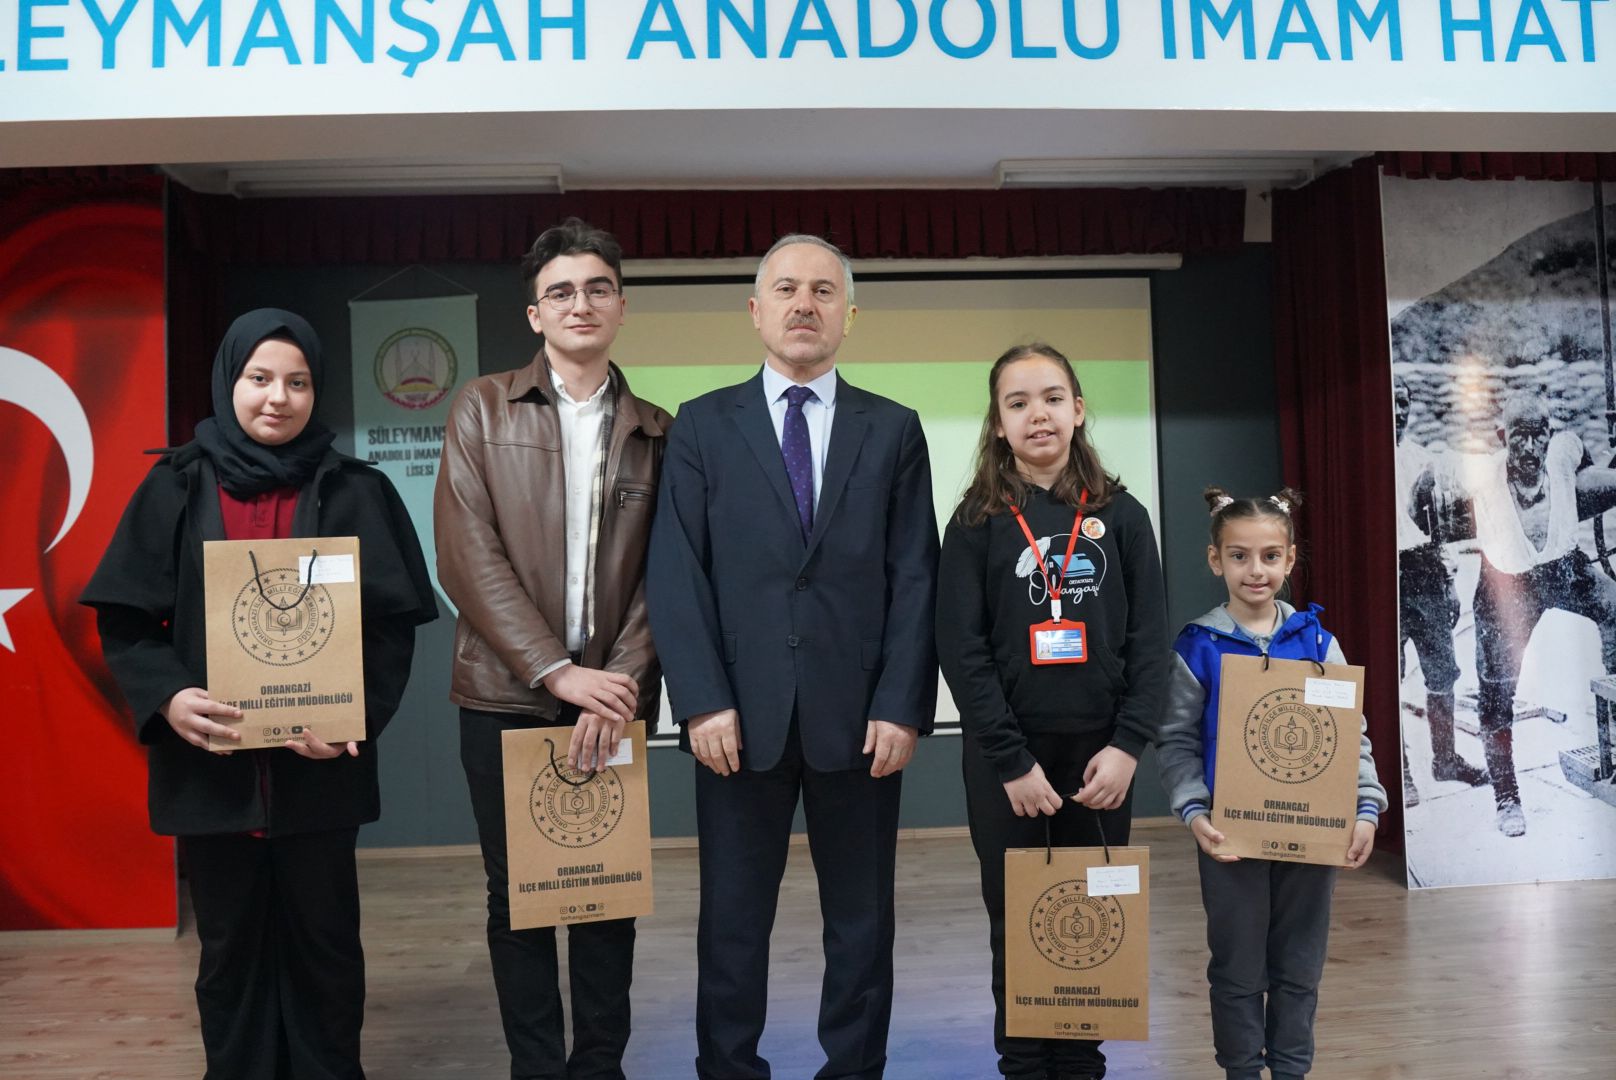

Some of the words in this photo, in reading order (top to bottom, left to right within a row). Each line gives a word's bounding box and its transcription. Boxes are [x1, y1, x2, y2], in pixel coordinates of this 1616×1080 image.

[0, 0, 587, 79] EYMANŞAH
[627, 0, 1121, 60] ANADOLU
[368, 449, 411, 462] ANADOLU
[405, 461, 434, 477] LİSESİ
[260, 682, 312, 696] ORHANGAZİ
[239, 698, 263, 711] MİLLİ
[264, 695, 296, 709] EĞİTİM
[297, 692, 353, 707] MÜDÜRLÜĞÜ
[1264, 799, 1309, 813] ORHANGAZİ
[1224, 807, 1242, 821] İLÇE
[1243, 809, 1265, 821] MİLLİ
[1266, 812, 1295, 825] EĞİTİM
[1296, 815, 1346, 829] MÜDÜRLÜĞÜ
[557, 862, 604, 877] ORHANGAZİ
[519, 882, 537, 894] İLÇE
[538, 878, 560, 891] MİLLİ
[561, 875, 590, 889] EĞİTİM
[591, 870, 642, 886] MÜDÜRLÜĞÜ
[1054, 985, 1101, 996] ORHANGAZİ
[1016, 994, 1032, 1007] İLÇE
[1034, 995, 1056, 1006] MİLLİ
[1057, 996, 1086, 1007] EĞİTİM
[1087, 996, 1139, 1008] MÜDÜRLÜĞÜ
